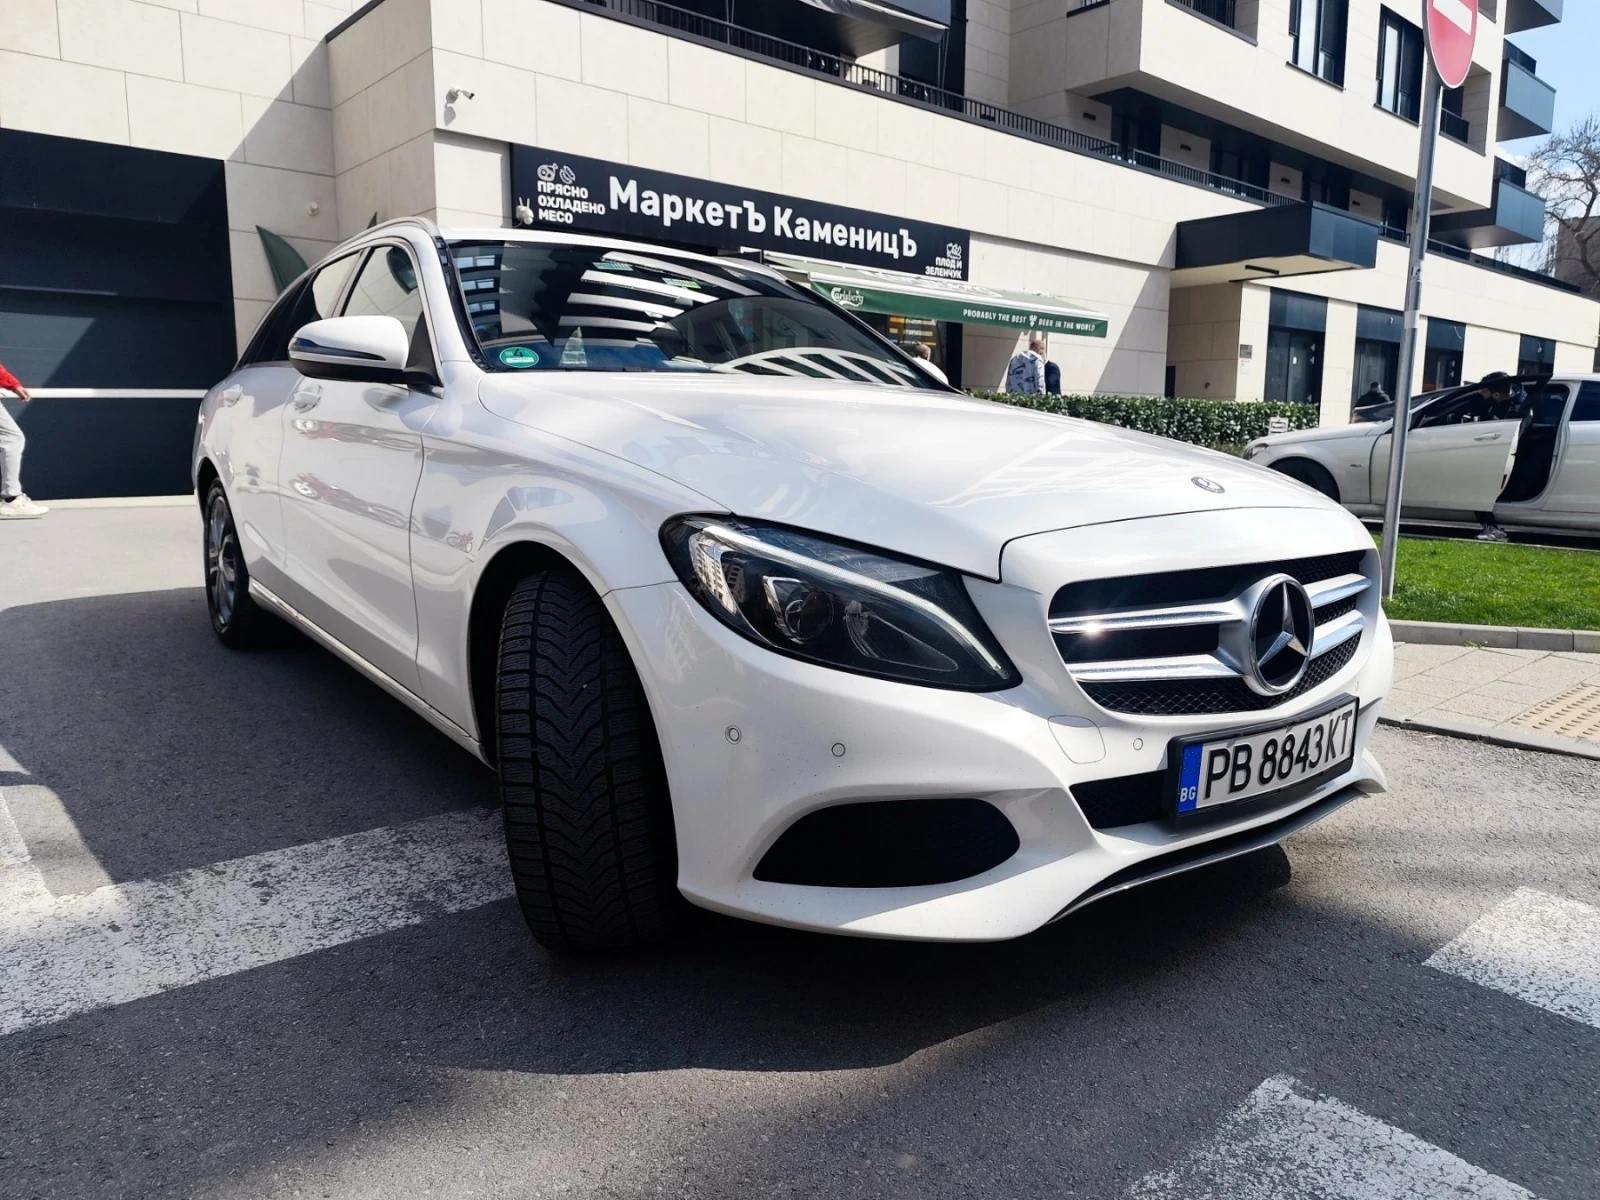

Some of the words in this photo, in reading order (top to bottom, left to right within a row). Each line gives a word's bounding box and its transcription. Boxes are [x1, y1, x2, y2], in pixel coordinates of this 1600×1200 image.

[537, 180, 589, 199] ПРЯСНО
[537, 194, 606, 215] ОХЛАДЕНО
[538, 208, 574, 224] МЕСО
[608, 175, 767, 234] МаркетЪ
[773, 207, 918, 259] КаменицЪ
[924, 265, 963, 279] ЗЕЛЕНЧУК
[935, 256, 956, 270] ПЛОД
[830, 286, 864, 307] Carlsberg
[963, 308, 997, 320] PROBABLY
[998, 313, 1010, 322] THE
[1011, 315, 1027, 324] BEST
[1038, 318, 1053, 327] BEER
[1055, 320, 1062, 328] IN
[1063, 322, 1075, 330] THE
[1076, 323, 1096, 332] WORLD
[1204, 743, 1253, 800] PB
[1258, 723, 1325, 786] 8843
[1324, 709, 1353, 763] KT
[1179, 786, 1197, 803] BG
